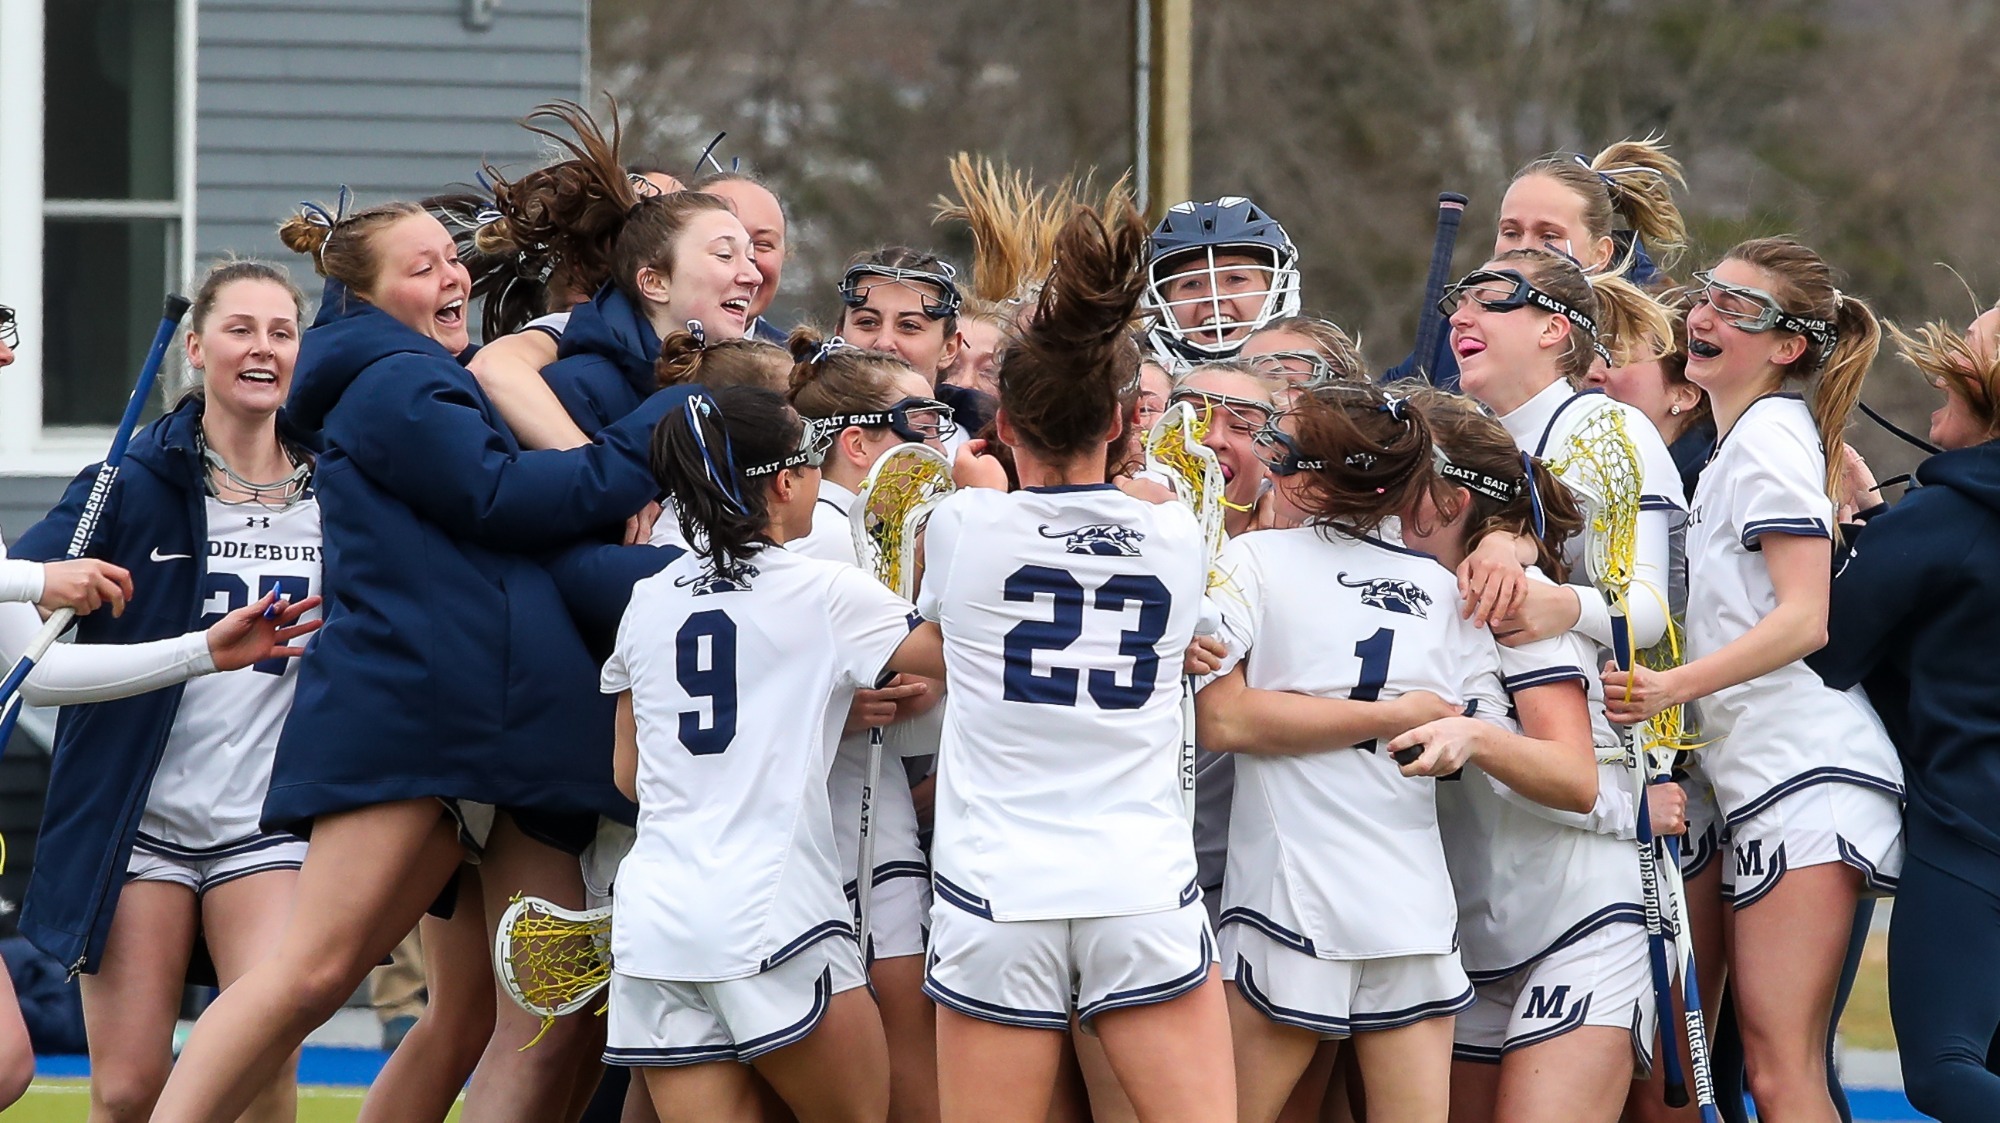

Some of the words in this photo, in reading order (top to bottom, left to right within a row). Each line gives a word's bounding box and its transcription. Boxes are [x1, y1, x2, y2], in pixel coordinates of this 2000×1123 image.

[1537, 294, 1567, 314] GAIT
[849, 413, 882, 425] GAIT
[745, 461, 780, 477] GAIT
[785, 452, 807, 467] GAI
[1443, 464, 1478, 482] GAIT
[1482, 475, 1509, 493] GAIT
[66, 461, 114, 558] MIDDLEBURY
[206, 540, 324, 563] DDLEBUR
[1002, 564, 1171, 711] 23
[675, 609, 738, 756] 9
[1183, 740, 1194, 791] GAIT
[860, 785, 871, 838] GAIT
[1734, 839, 1765, 877] M
[1637, 842, 1662, 936] MIDDLEBURY
[1521, 984, 1572, 1020] M
[1685, 1010, 1712, 1107] MIDDLEBURY
